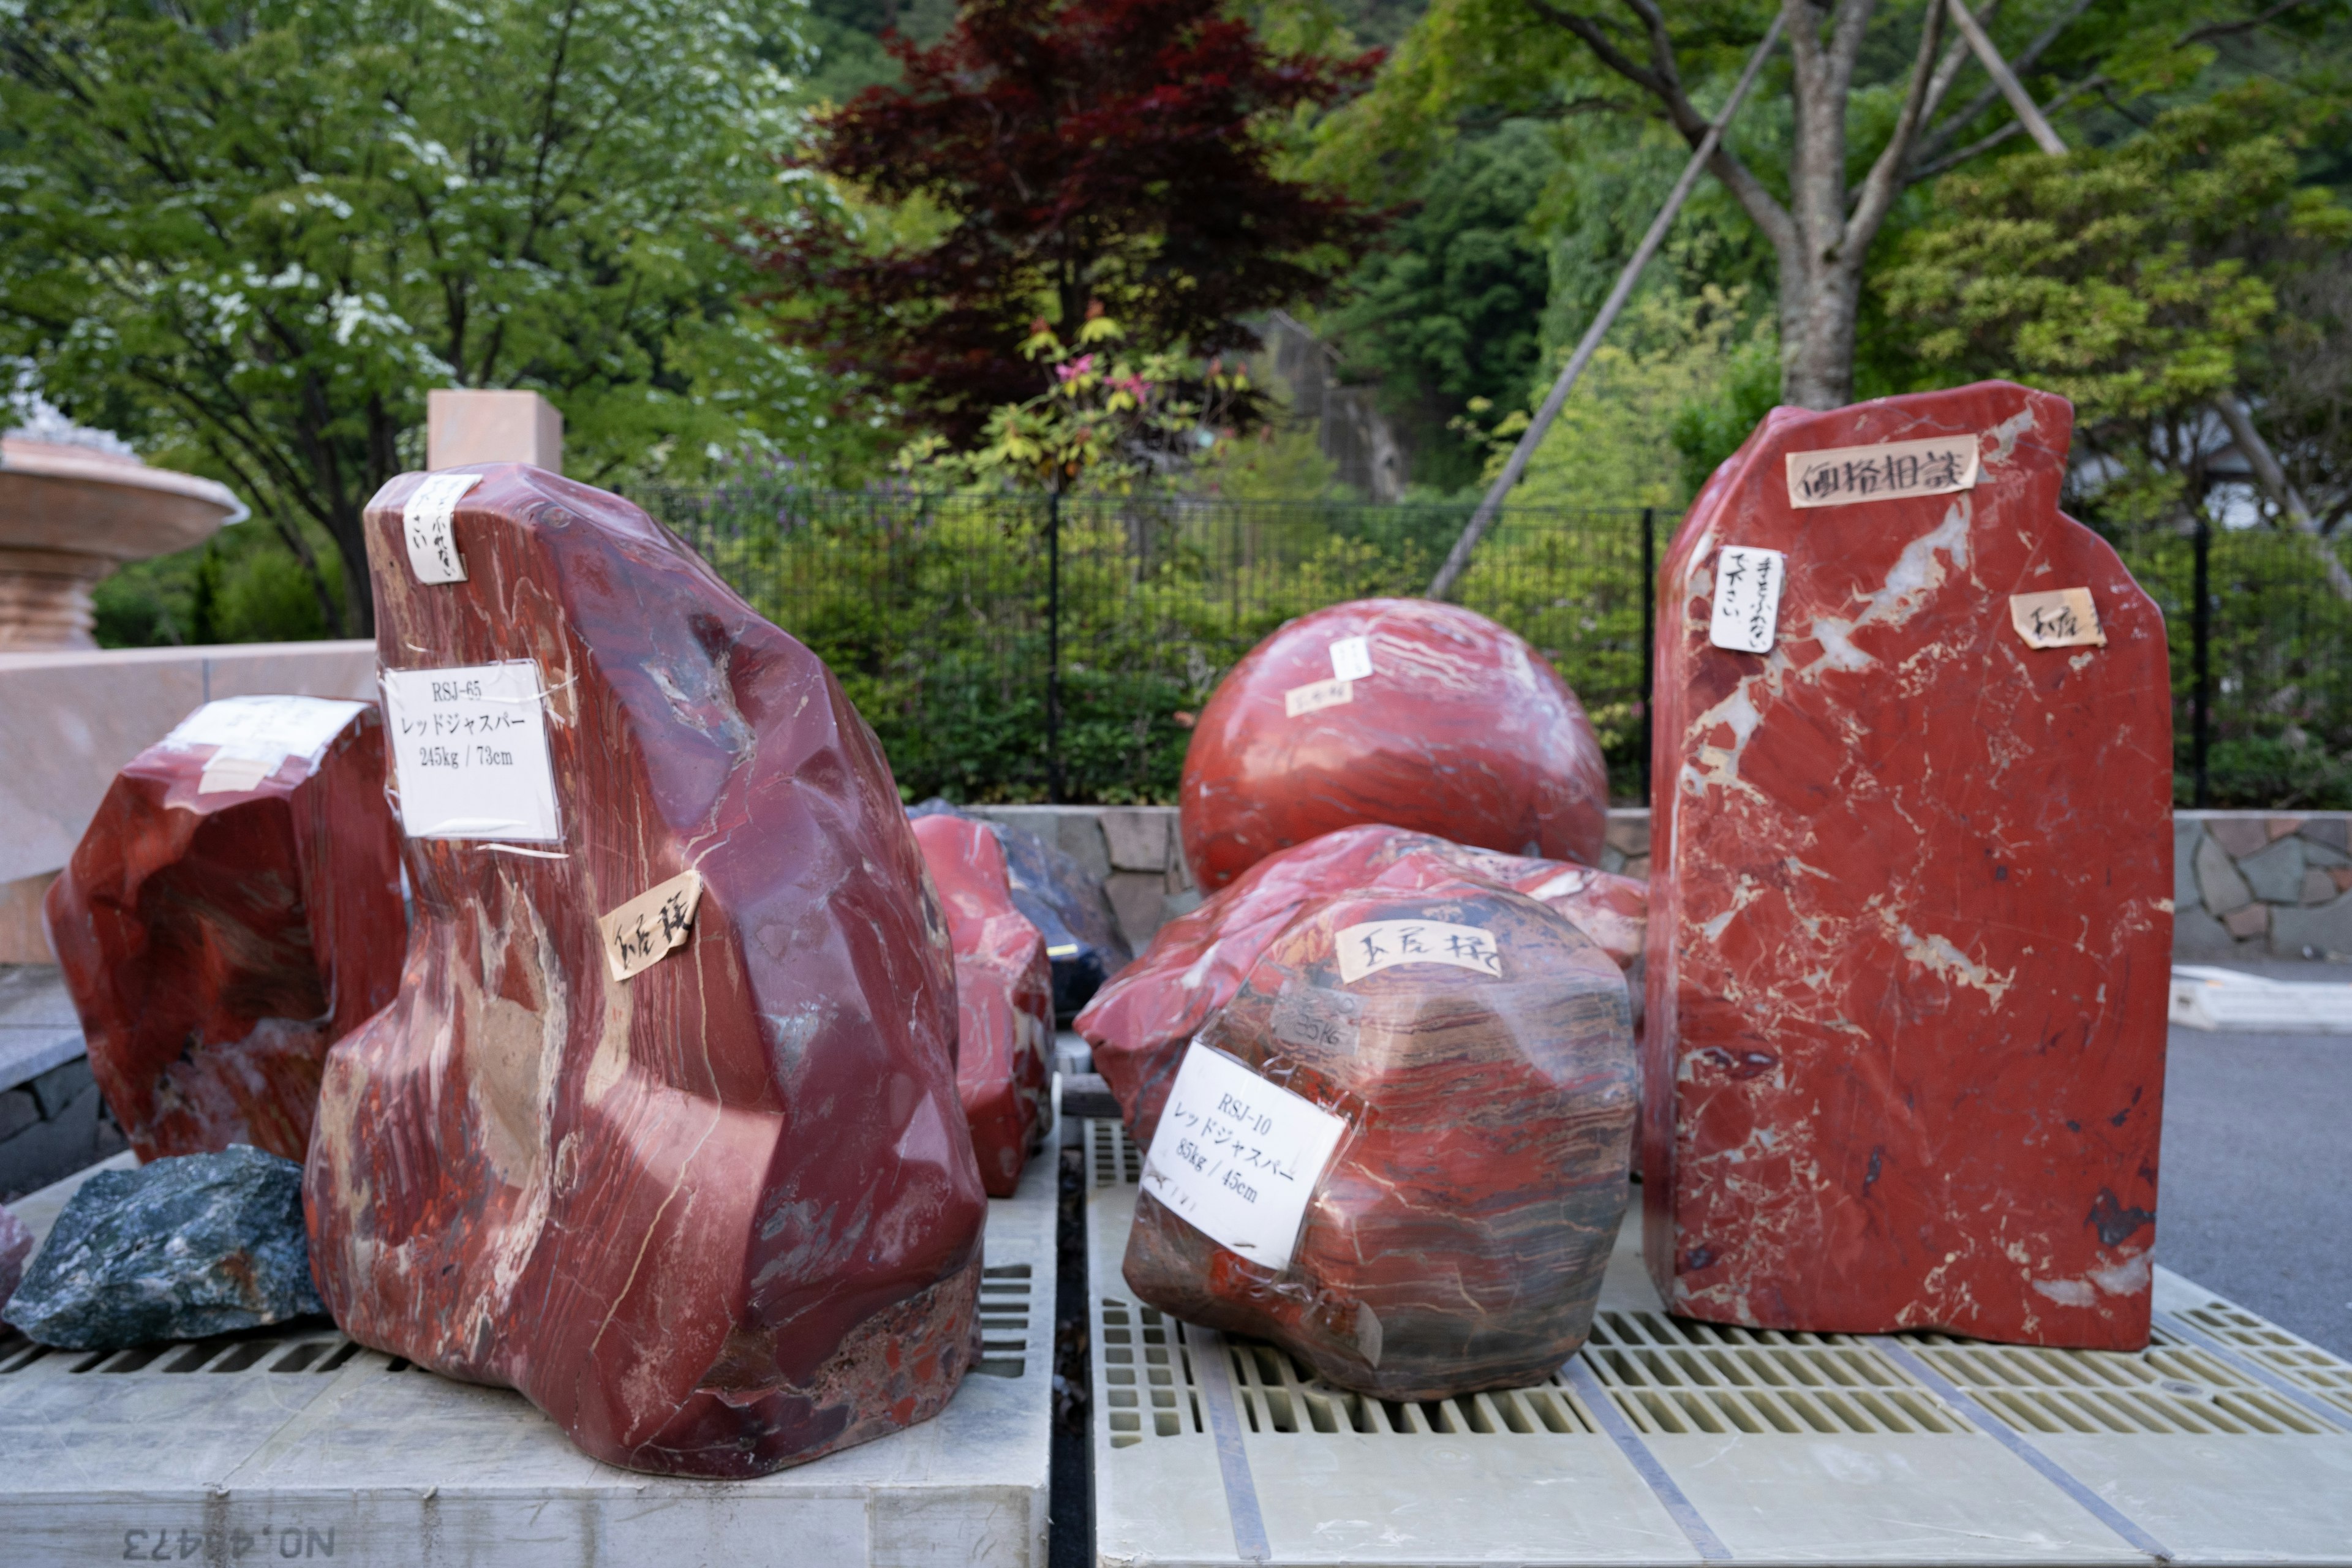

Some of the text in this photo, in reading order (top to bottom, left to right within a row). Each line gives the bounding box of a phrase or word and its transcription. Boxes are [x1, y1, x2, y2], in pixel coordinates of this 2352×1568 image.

[1796, 450, 1964, 500] 価格相談
[432, 680, 481, 701] RSJ-65
[401, 712, 525, 736] レッドジャスパー
[420, 746, 459, 769] 245kg
[477, 745, 513, 765] 73cm
[1218, 1093, 1272, 1136] RSJ-10
[1174, 1101, 1294, 1181] レッドジャスパー
[1176, 1137, 1208, 1173] 85kg
[1221, 1168, 1258, 1204] 45cm
